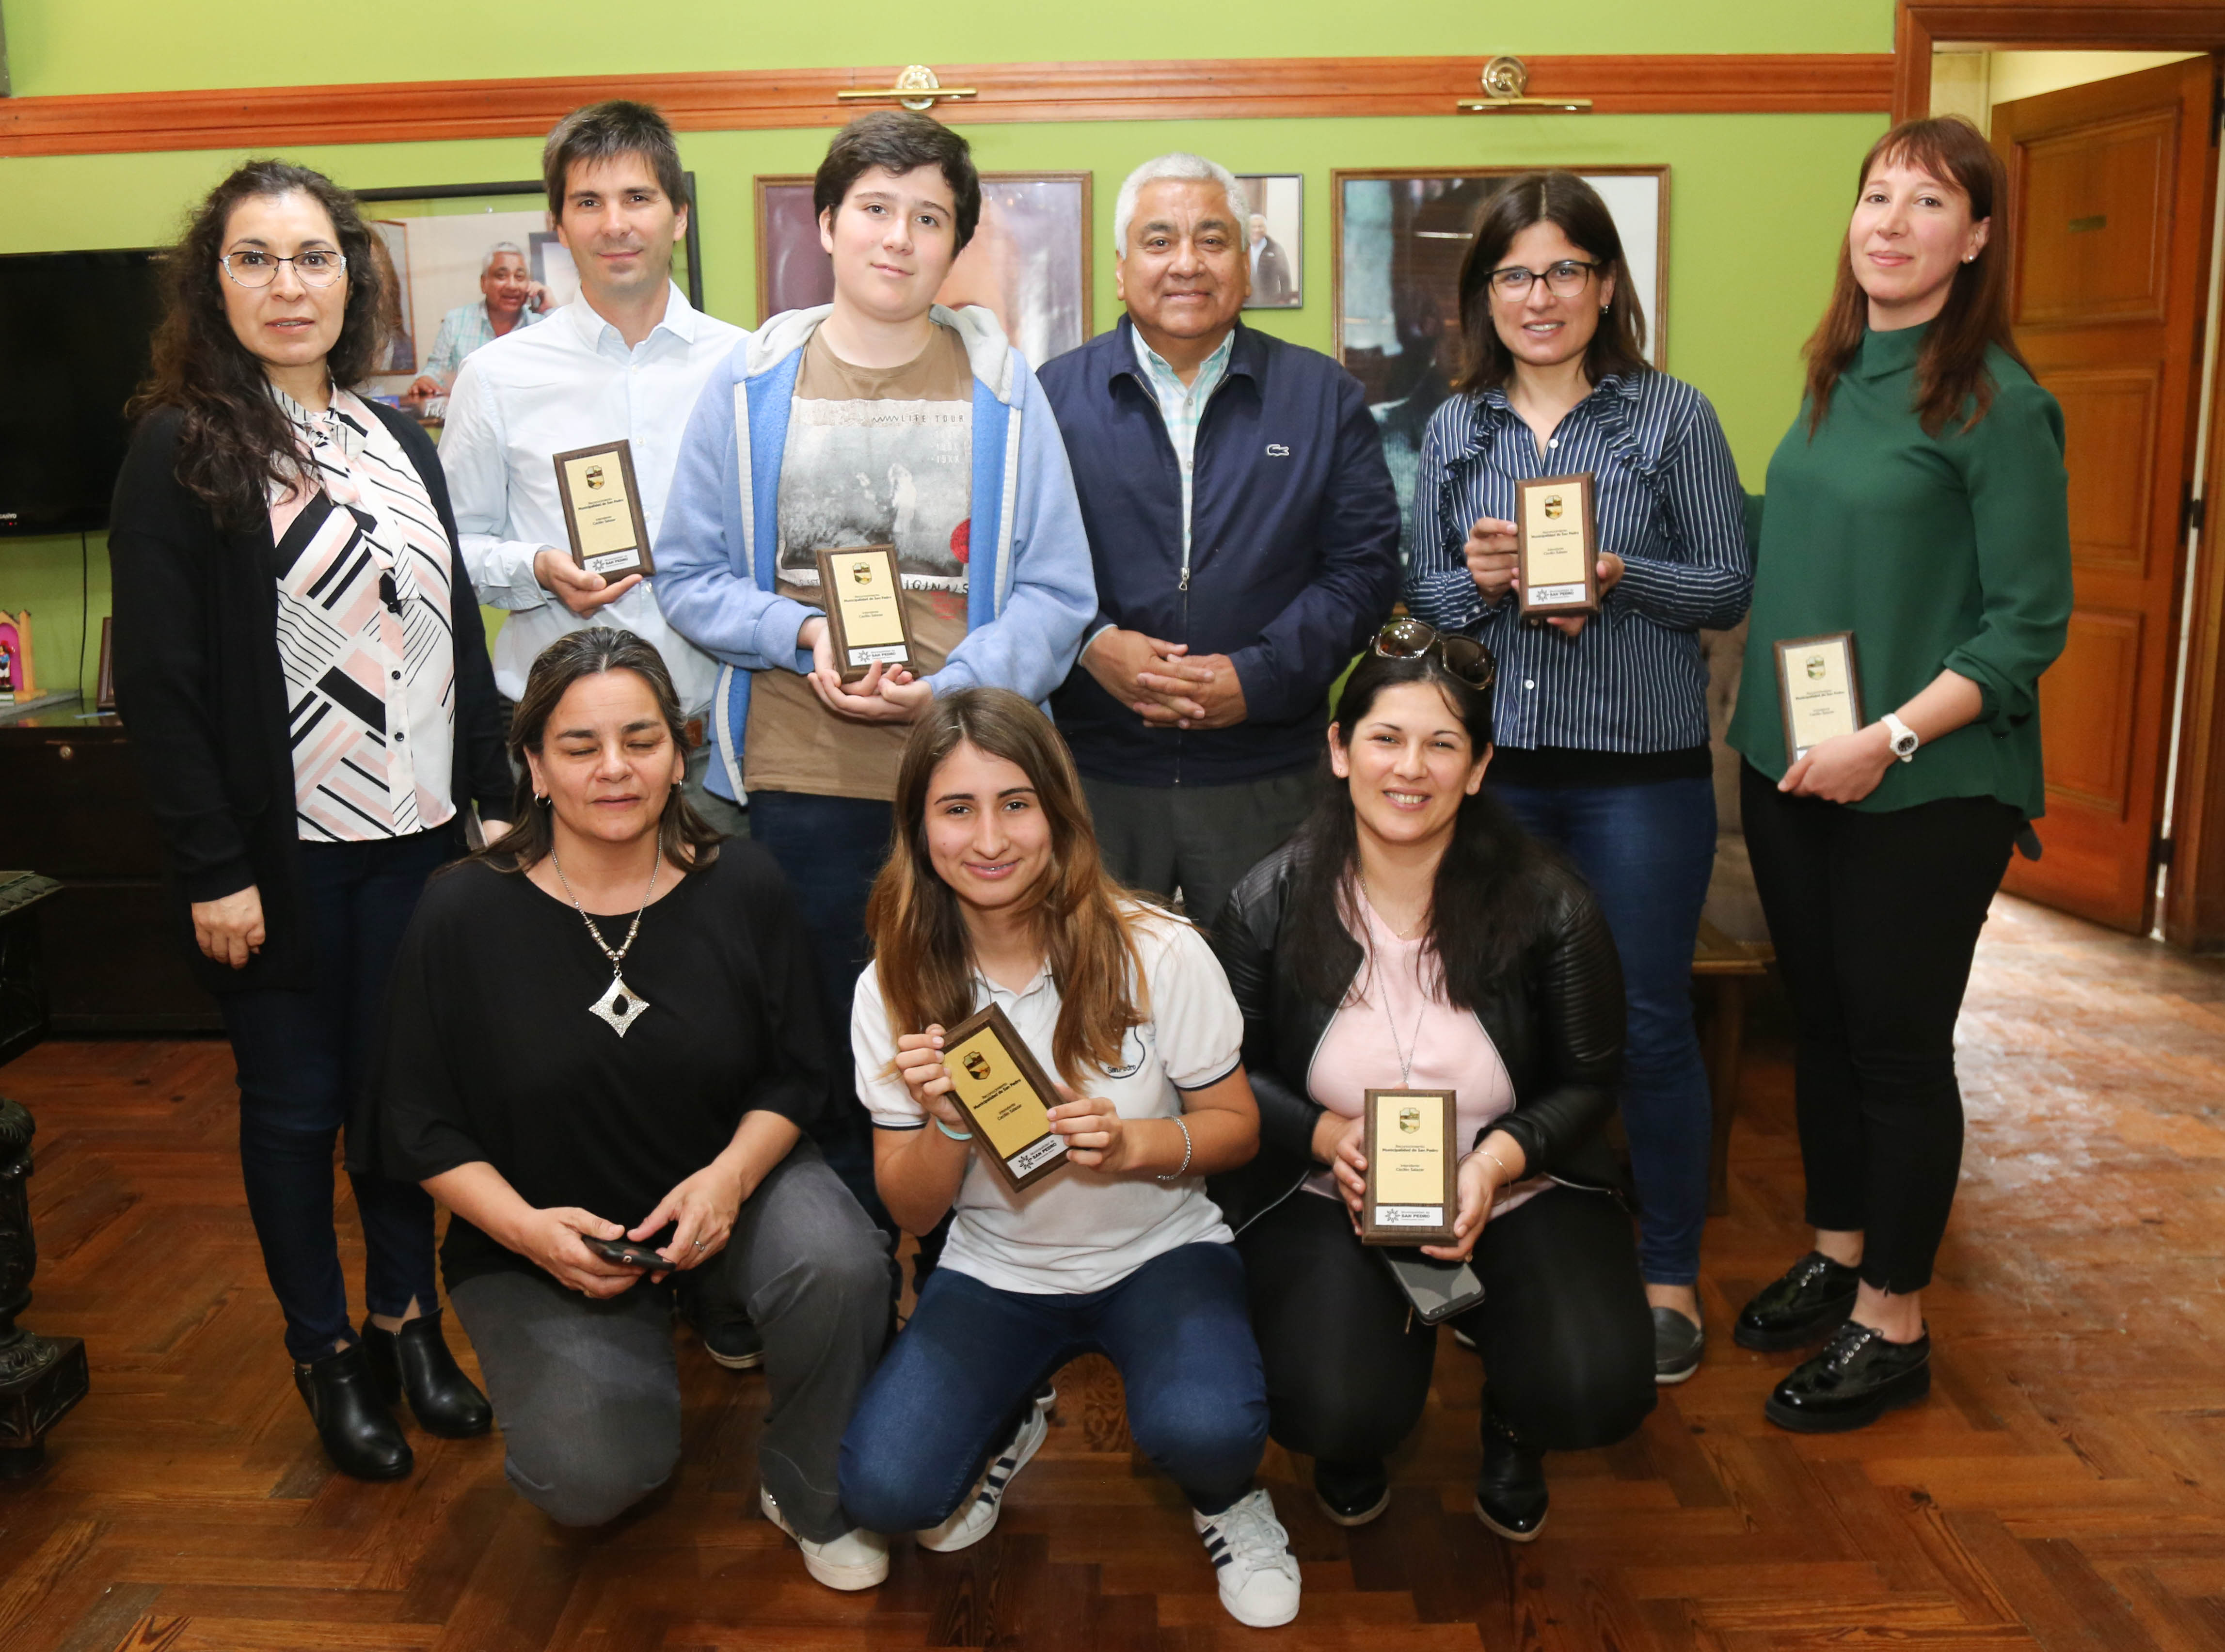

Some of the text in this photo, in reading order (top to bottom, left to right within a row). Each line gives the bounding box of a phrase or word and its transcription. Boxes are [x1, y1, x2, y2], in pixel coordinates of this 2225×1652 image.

[935, 414, 964, 423] TOUR
[973, 1093, 998, 1109] Municipalidad
[1042, 1143, 1057, 1153] PEDRO
